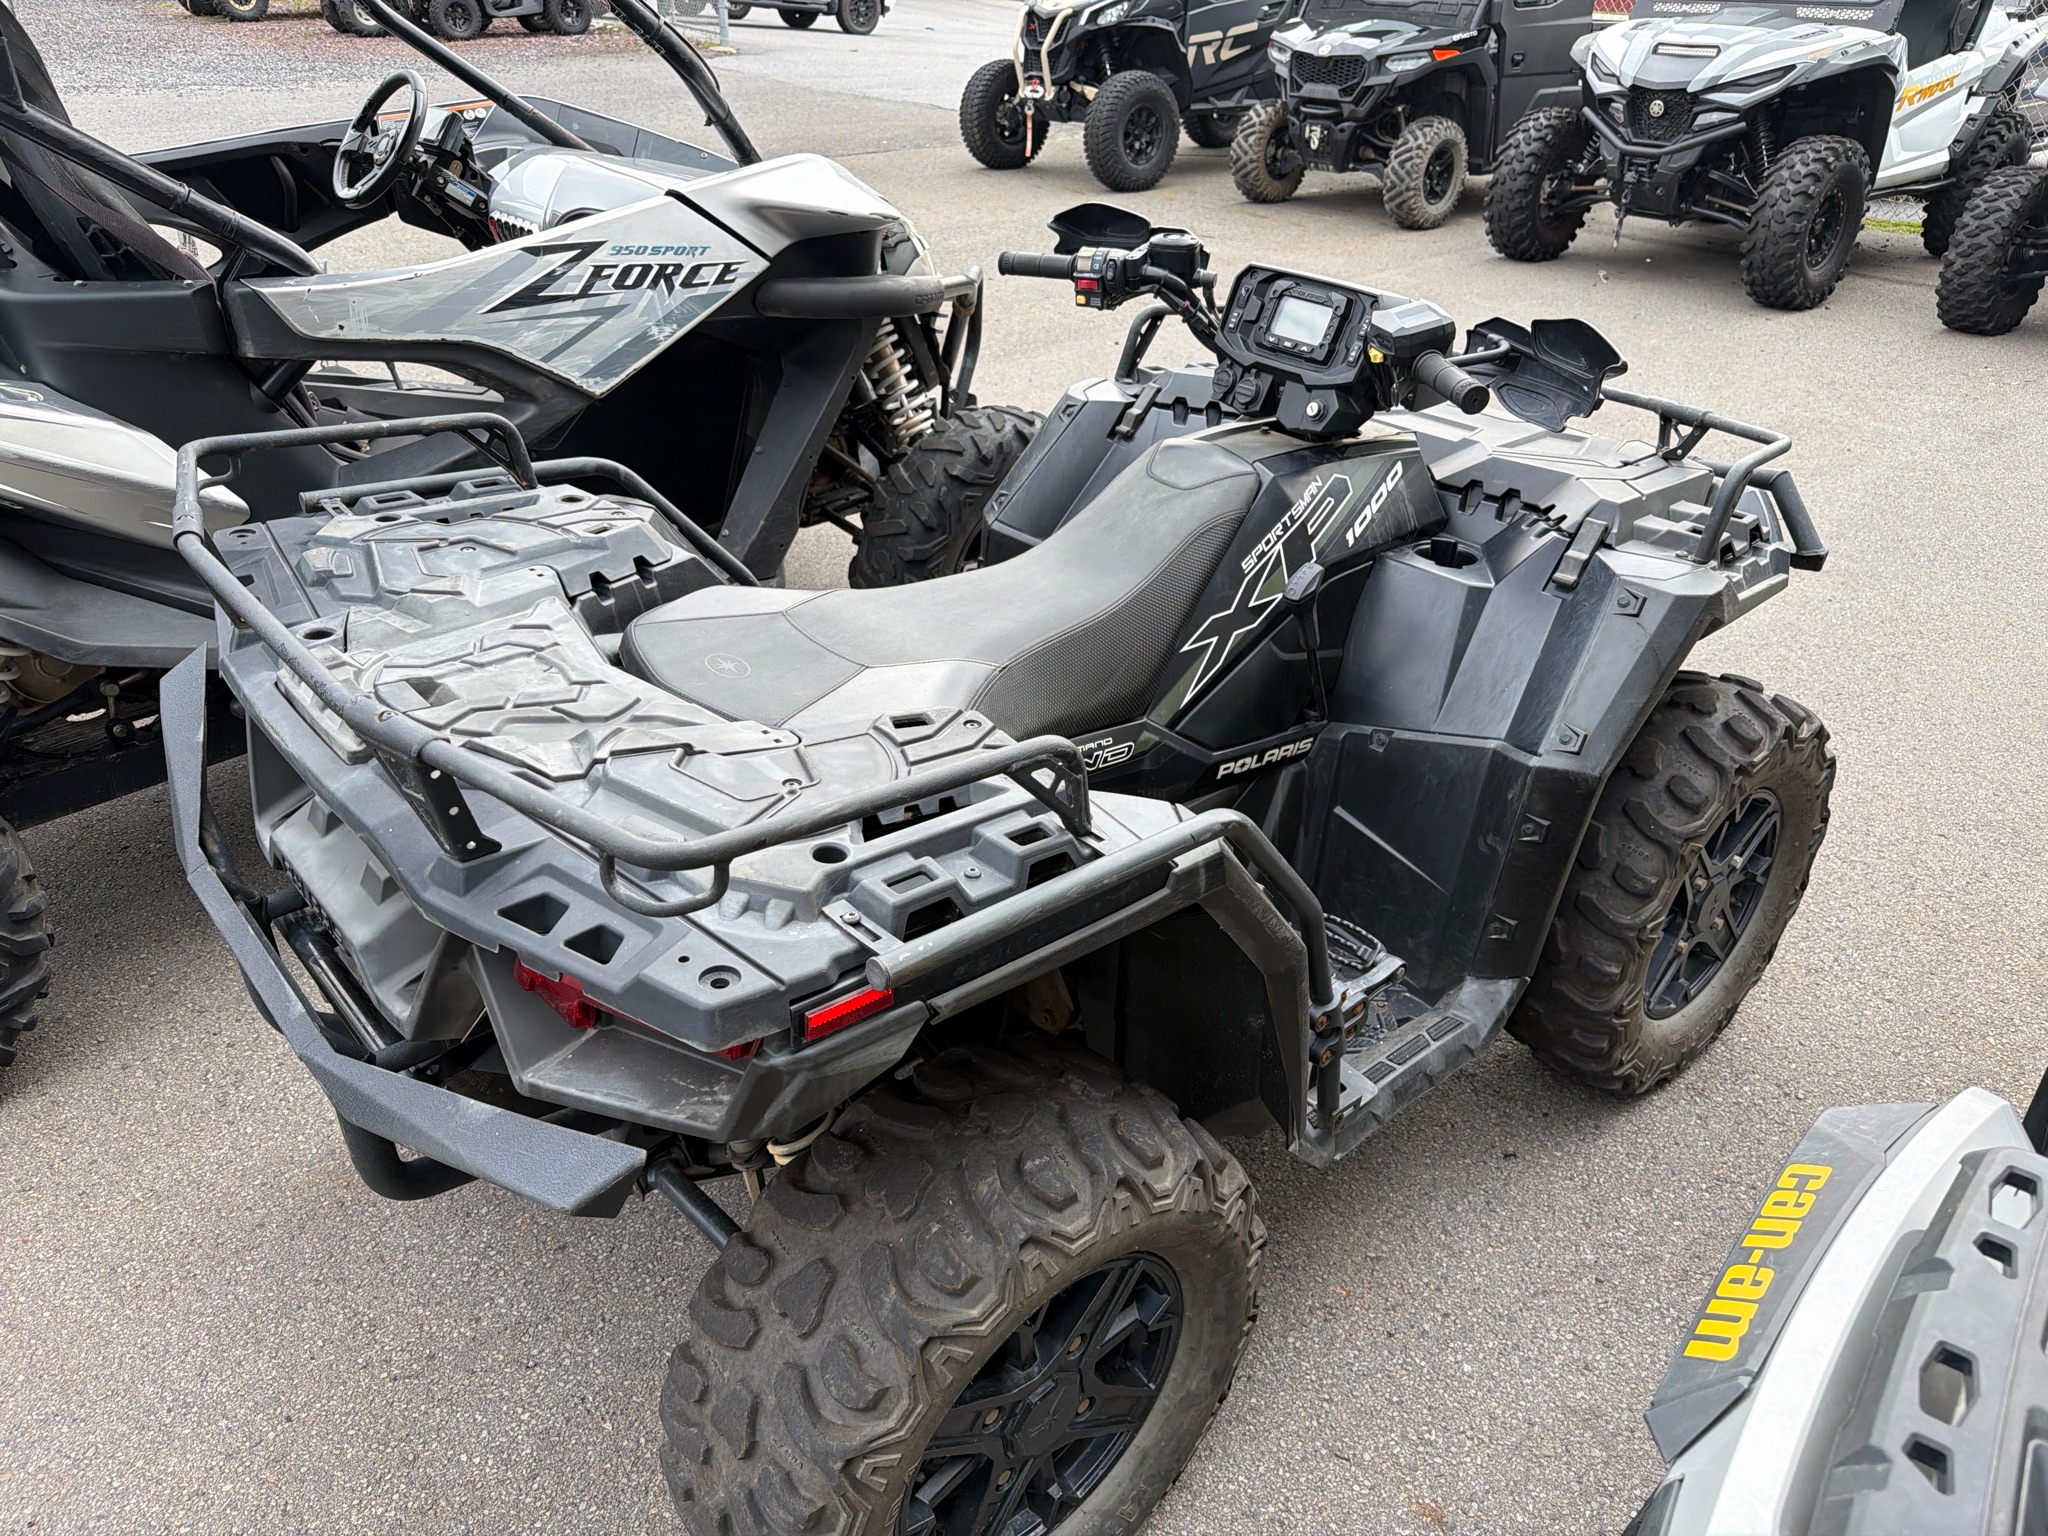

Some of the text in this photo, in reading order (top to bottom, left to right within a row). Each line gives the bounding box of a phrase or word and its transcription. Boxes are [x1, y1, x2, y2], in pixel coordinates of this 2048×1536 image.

[1187, 21, 1259, 69] RC
[608, 245, 711, 259] 950 SPORT
[1241, 475, 1323, 574] SPORTSMAN
[1345, 460, 1403, 548] 1000
[1179, 474, 1353, 709] XP
[1216, 737, 1314, 780] POLARIS
[1683, 1163, 1833, 1361] can-am
